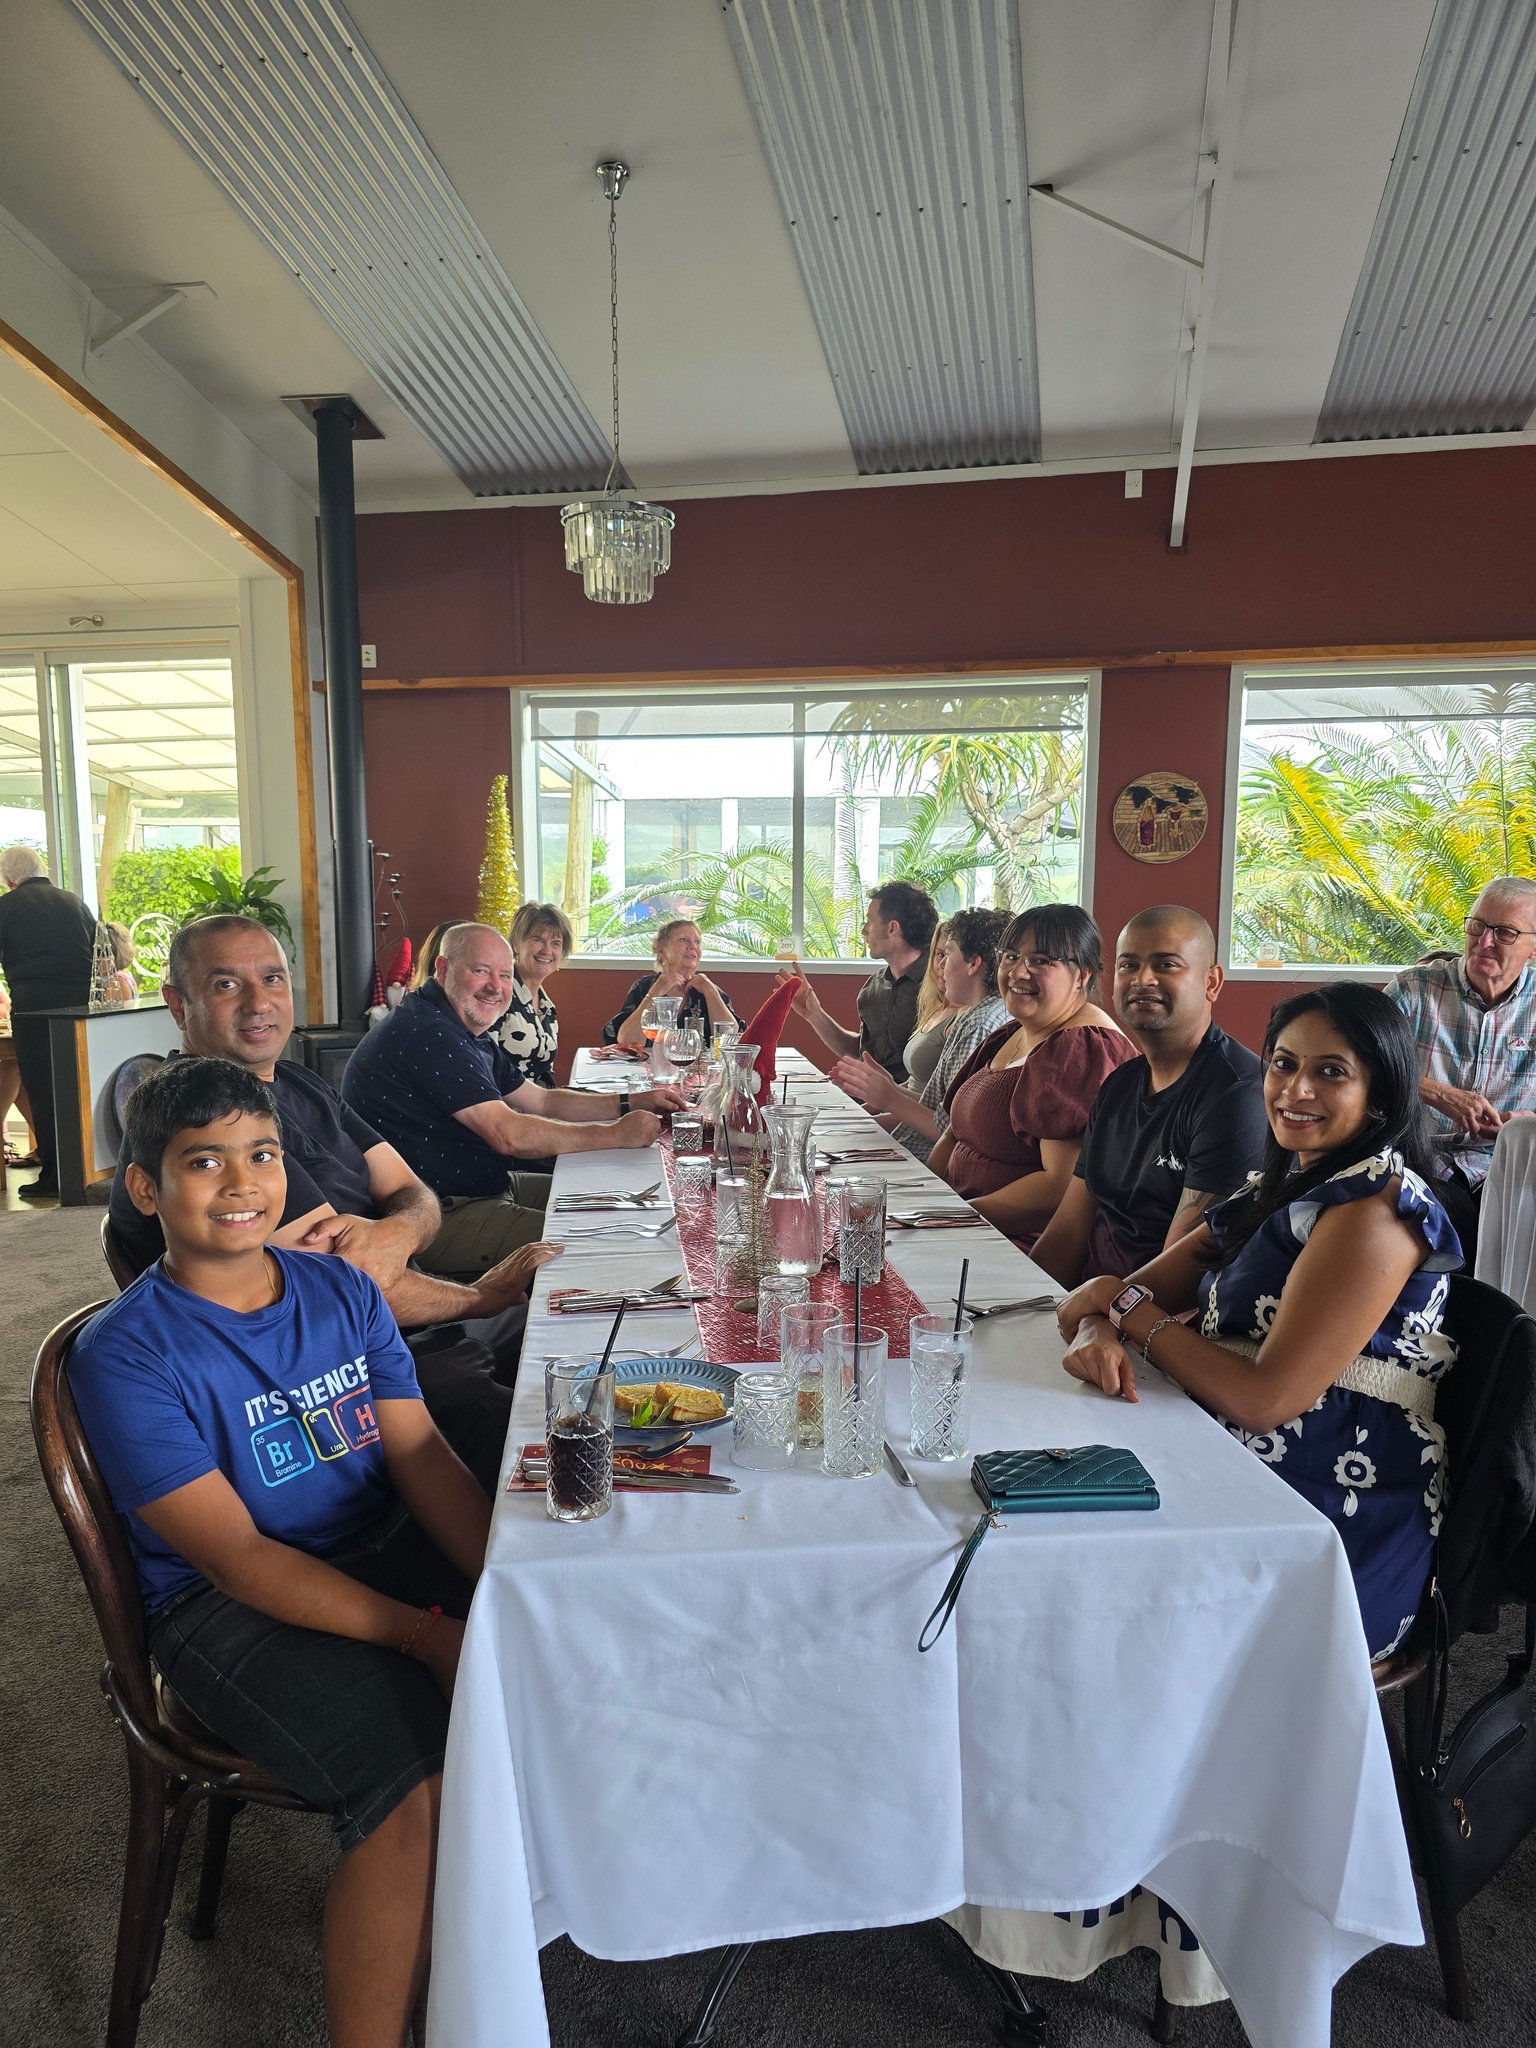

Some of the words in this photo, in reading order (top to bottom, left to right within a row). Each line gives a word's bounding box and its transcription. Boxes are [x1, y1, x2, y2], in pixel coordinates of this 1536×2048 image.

[244, 1390, 289, 1427] IT'S
[355, 1403, 375, 1430] H
[256, 1436, 265, 1445] 35
[356, 1428, 379, 1442] Hydrog
[266, 1440, 294, 1468] Br
[275, 1461, 302, 1477] Bromine
